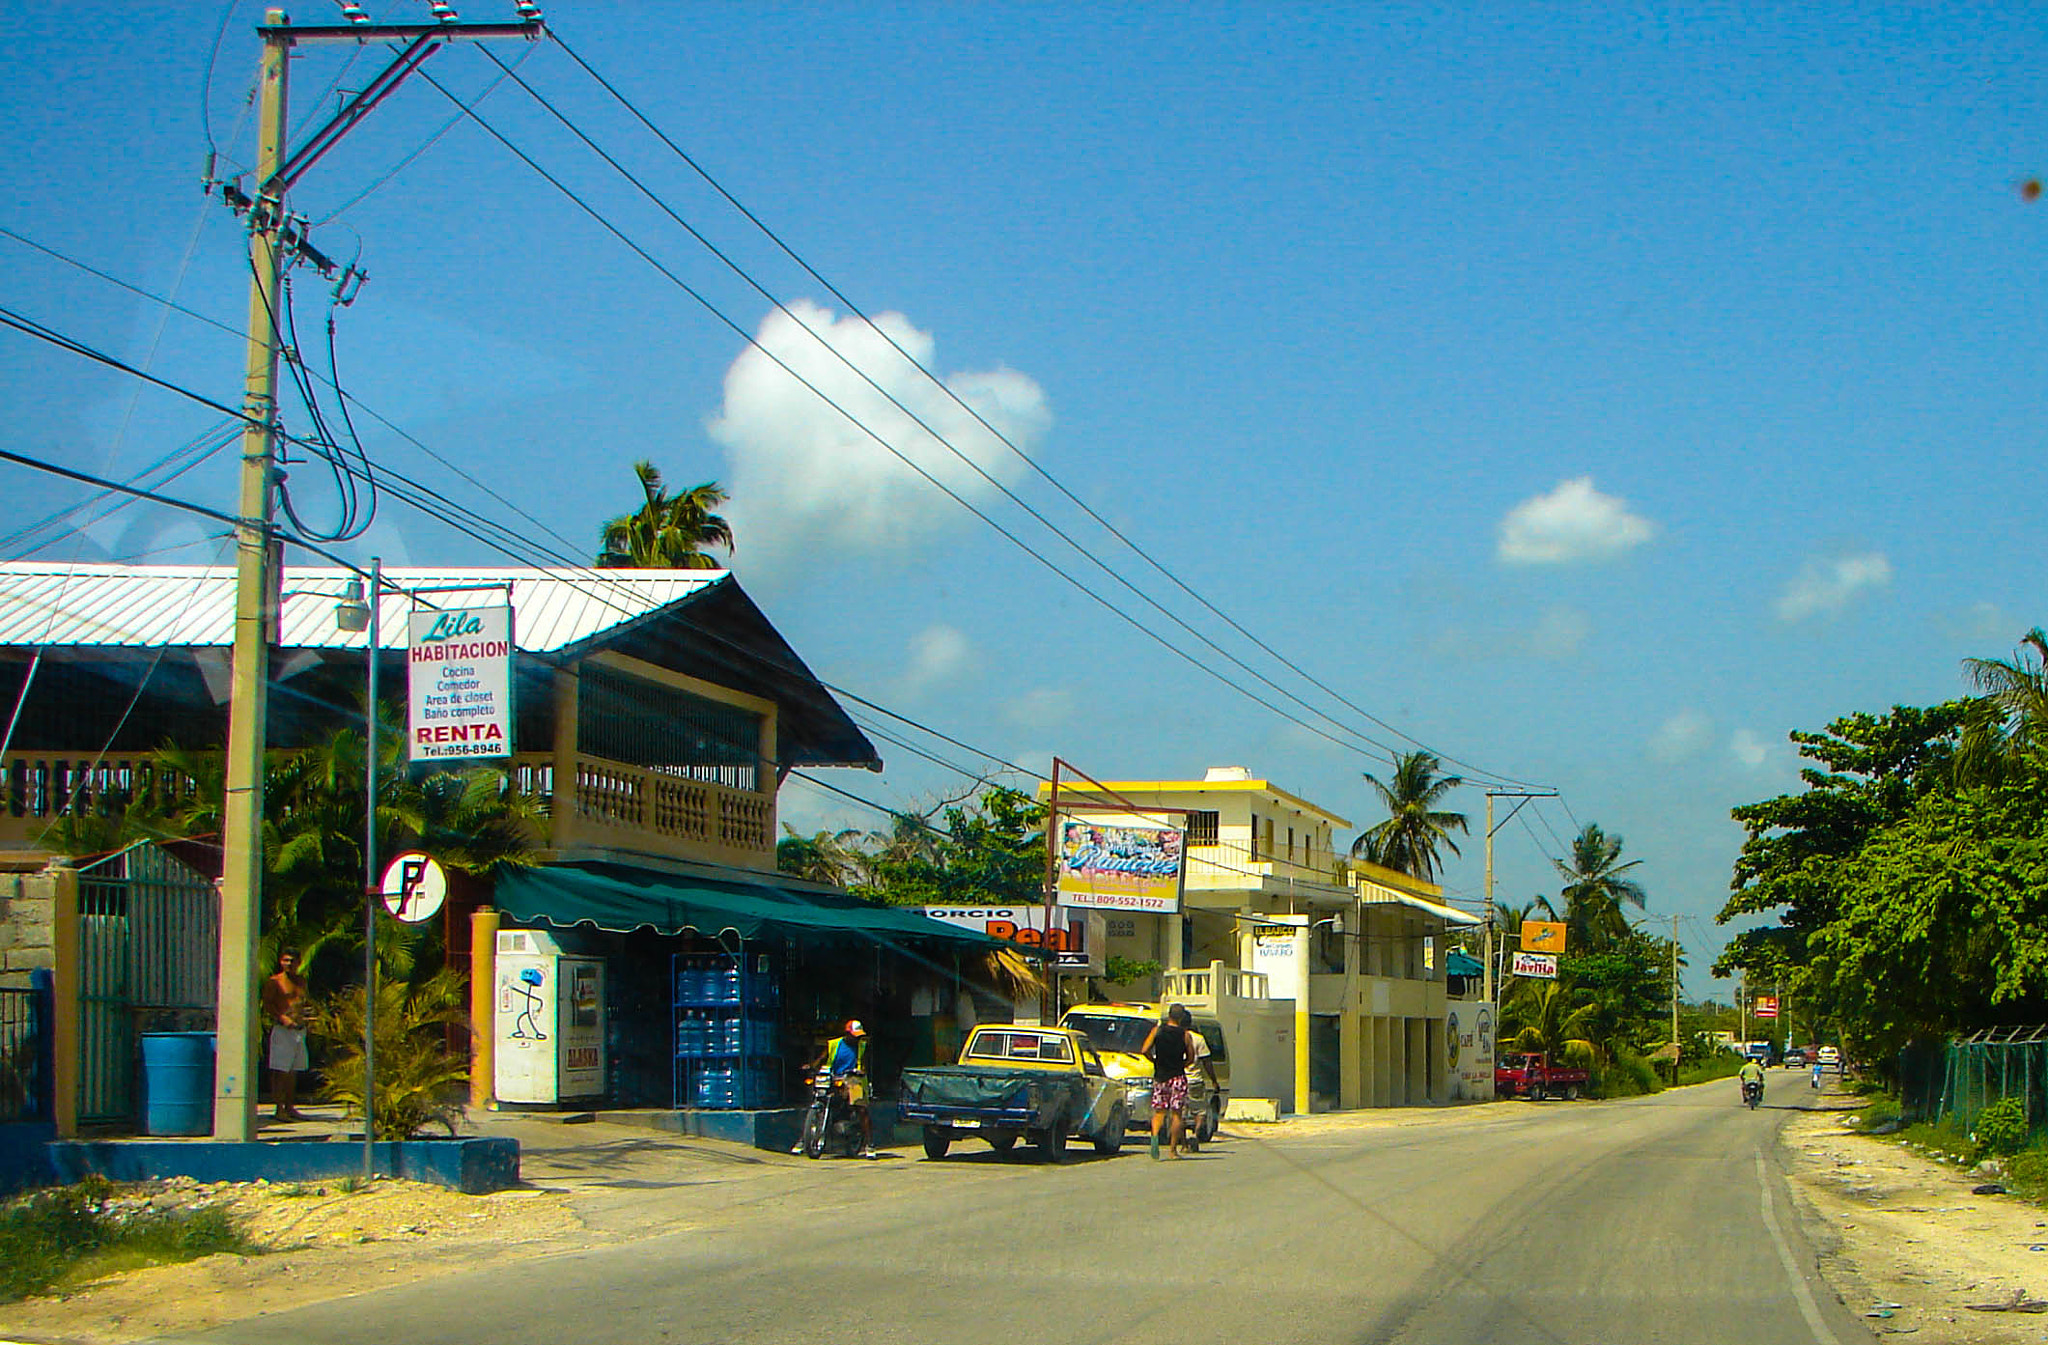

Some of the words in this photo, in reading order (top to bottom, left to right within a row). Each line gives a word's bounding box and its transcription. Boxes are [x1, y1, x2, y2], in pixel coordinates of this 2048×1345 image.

[421, 611, 486, 642] Lila
[412, 641, 508, 662] HABITACION
[442, 666, 475, 679] Cocina
[437, 679, 480, 691] Comedor
[426, 694, 448, 706] Area
[451, 693, 462, 704] de
[464, 691, 494, 703] closet
[425, 708, 448, 720] Baño
[450, 704, 495, 719] completo
[417, 723, 503, 743] RENTA
[1096, 895, 1164, 908] 809-552-1572
[986, 920, 1084, 952] Real
[567, 1047, 599, 1069] ALASKA
